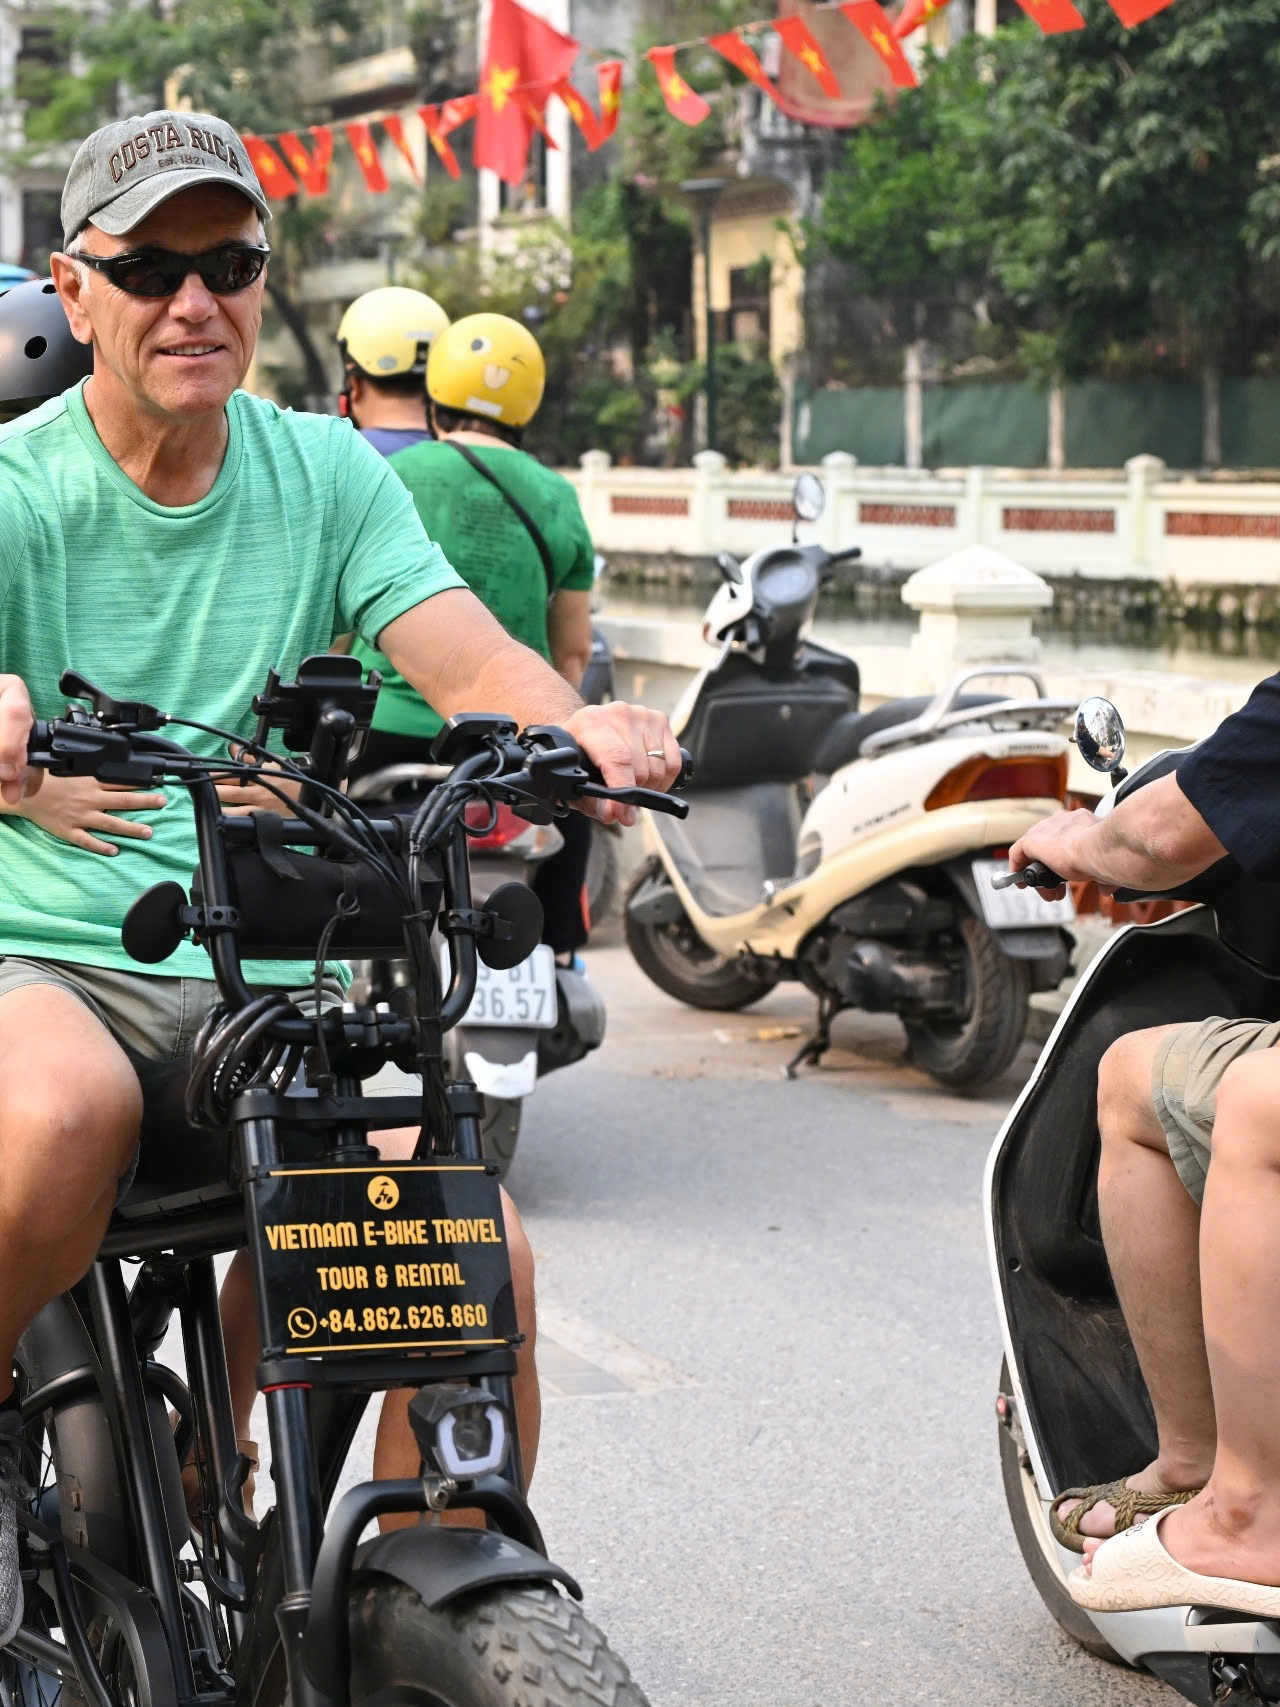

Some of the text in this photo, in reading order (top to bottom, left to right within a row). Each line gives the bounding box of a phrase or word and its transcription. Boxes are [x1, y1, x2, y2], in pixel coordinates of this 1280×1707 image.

[108, 121, 243, 184] COSTA RICA
[180, 154, 205, 167] 1821
[265, 1218, 502, 1251] VIETNAM E-BIKE TRAVEL
[316, 1263, 465, 1291] TOUR & RENTAL
[319, 1303, 488, 1333] +84.862.626.860
